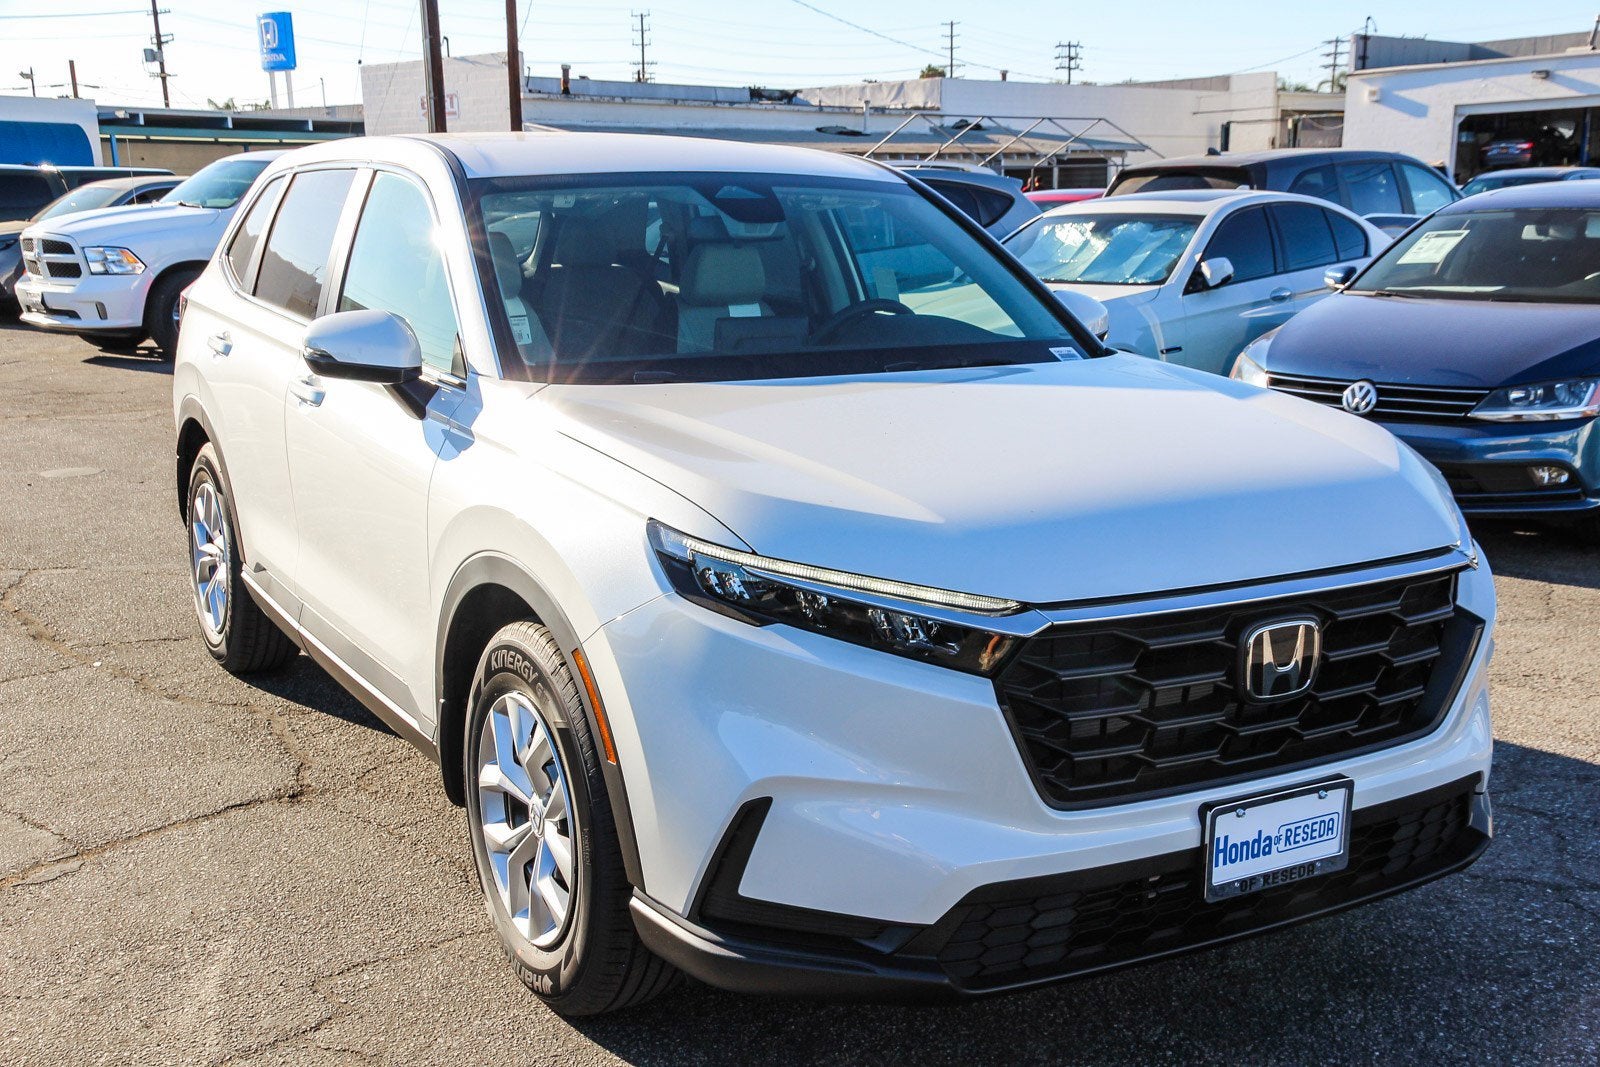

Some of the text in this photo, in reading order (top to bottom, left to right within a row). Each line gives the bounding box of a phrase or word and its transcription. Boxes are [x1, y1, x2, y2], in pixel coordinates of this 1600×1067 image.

[491, 649, 539, 683] KINERGY
[1214, 817, 1335, 868] Honda OF RESEDA
[1239, 863, 1316, 892] OF RESEDA
